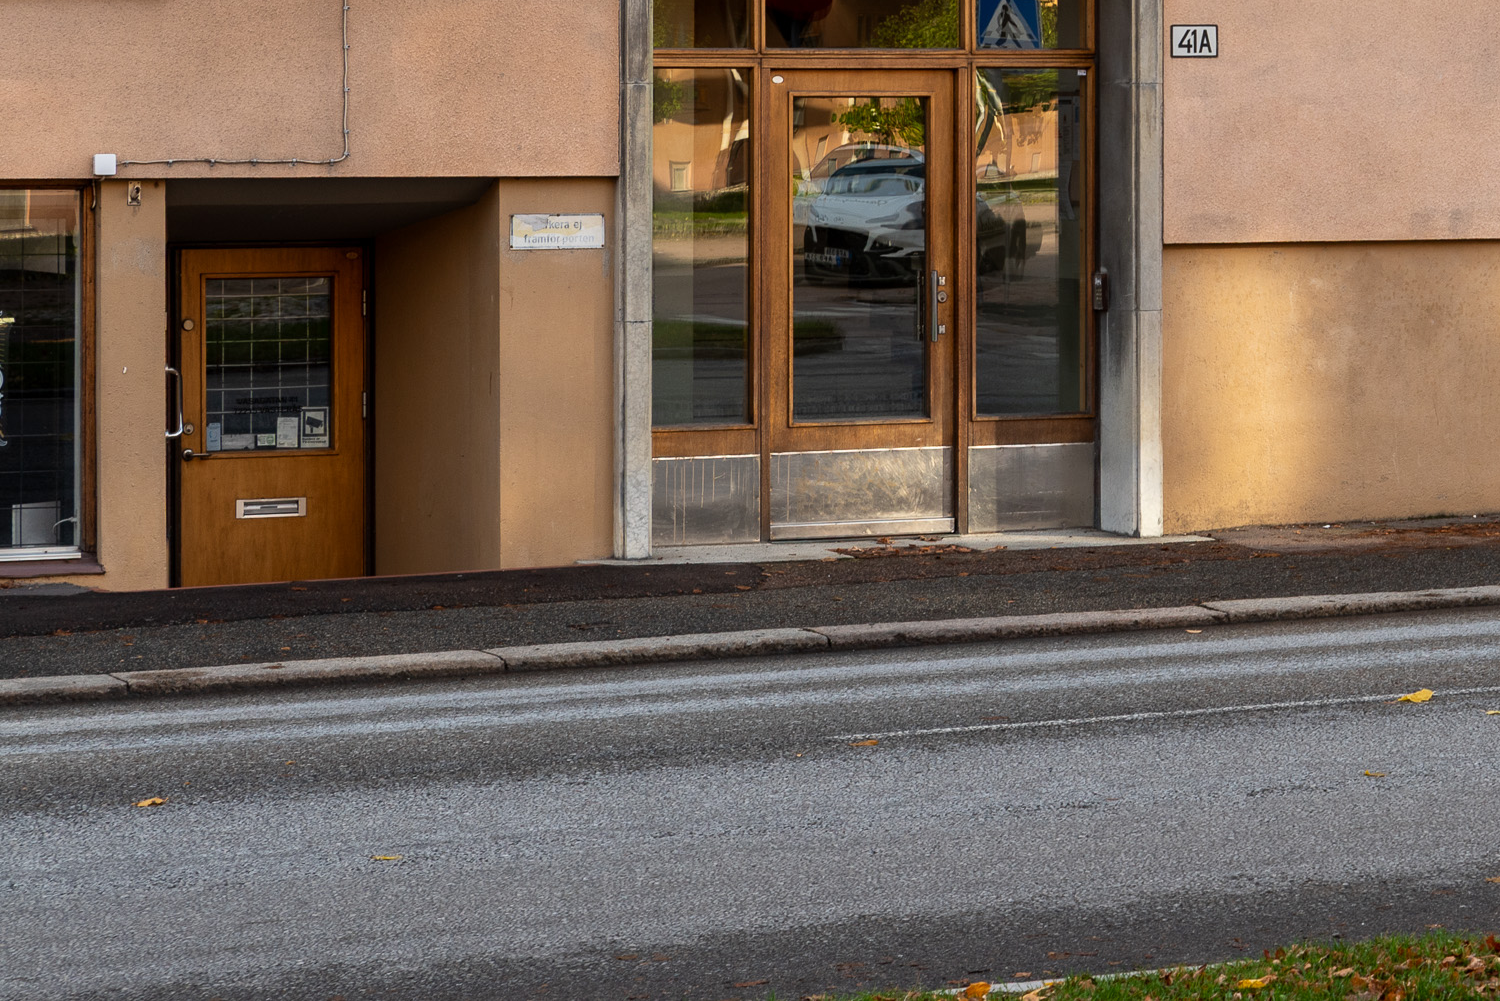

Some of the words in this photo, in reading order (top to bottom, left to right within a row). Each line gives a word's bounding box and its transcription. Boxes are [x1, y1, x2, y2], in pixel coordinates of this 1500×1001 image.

[1178, 29, 1213, 54] 41A
[573, 221, 582, 230] ej
[562, 234, 595, 245] porten
